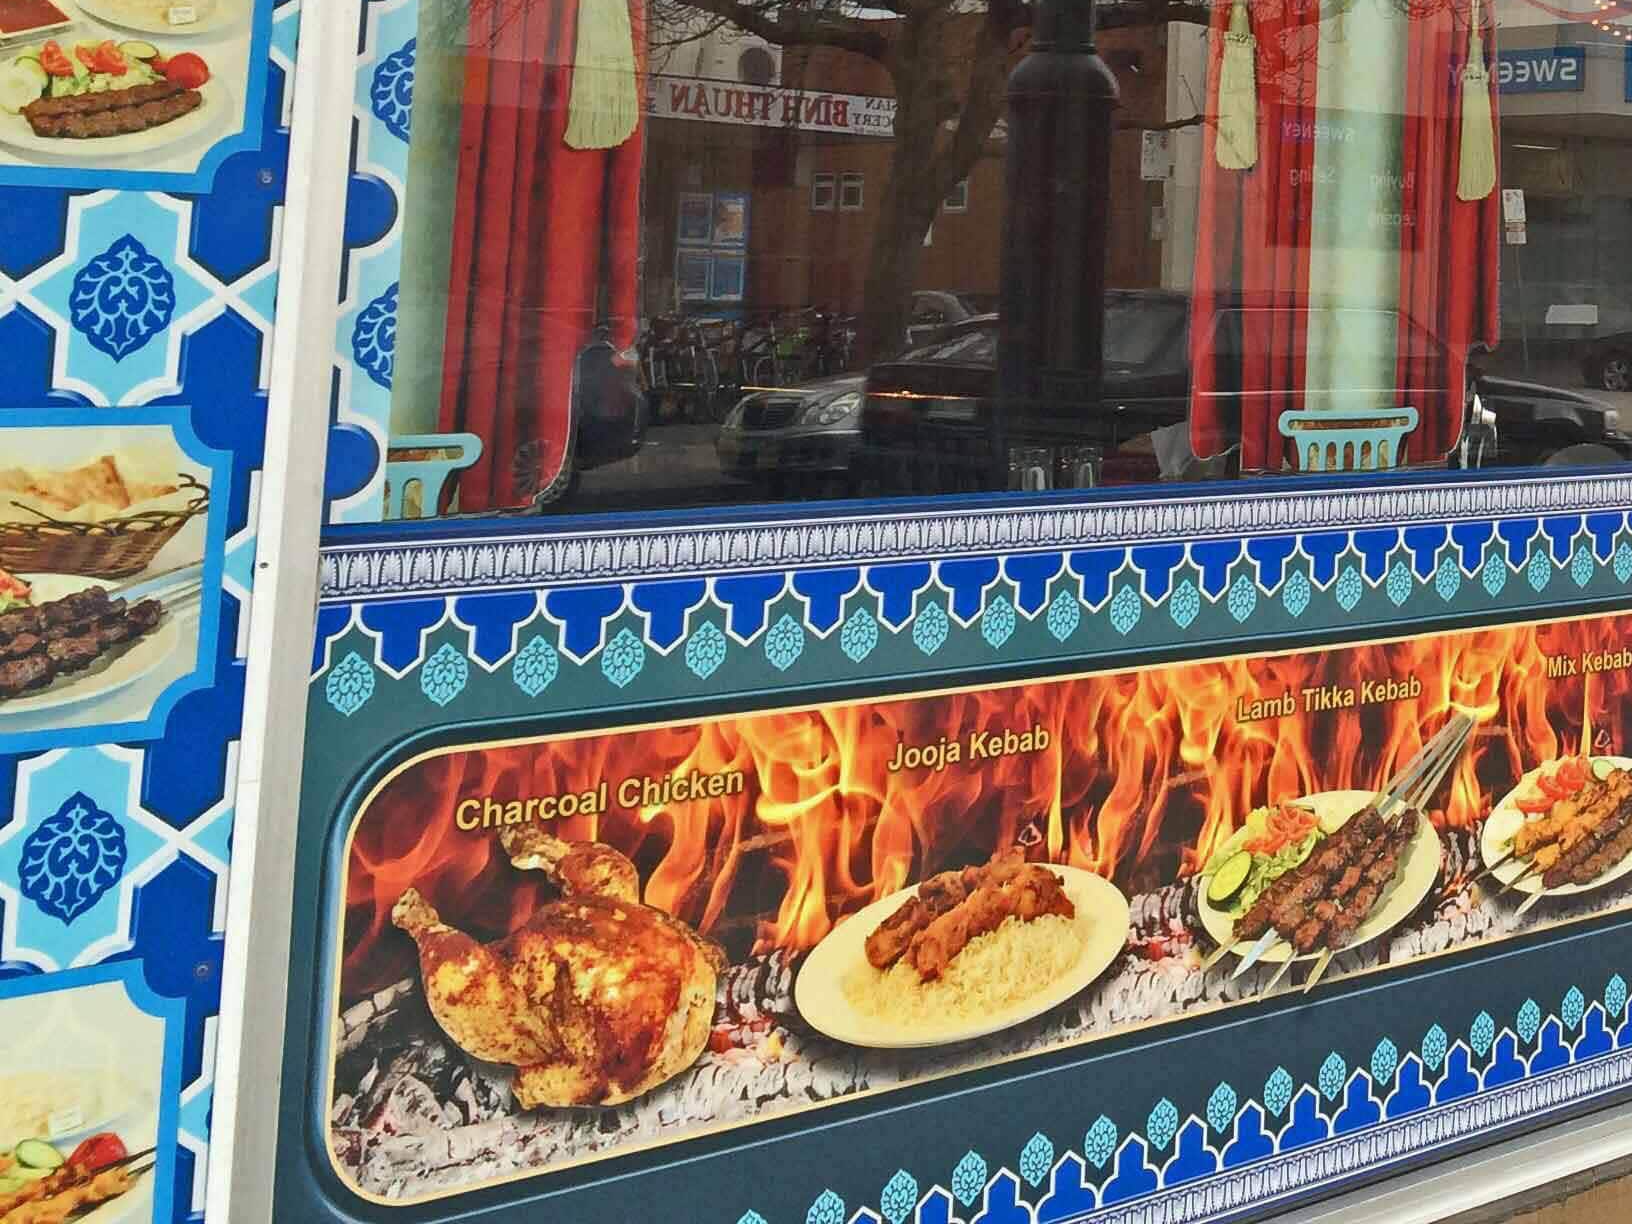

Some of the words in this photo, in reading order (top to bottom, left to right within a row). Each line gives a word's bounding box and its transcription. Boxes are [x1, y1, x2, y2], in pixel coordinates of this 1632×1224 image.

[1547, 655, 1578, 678] Mix
[1581, 648, 1632, 674] Kebab
[1236, 692, 1296, 724] Lamb
[1302, 683, 1355, 714] Tikka
[1360, 677, 1422, 706] Kebab
[887, 733, 962, 773] Jooja
[969, 725, 1050, 761] Kebab
[455, 782, 608, 832] Charcoal
[617, 766, 745, 812] Chicken
